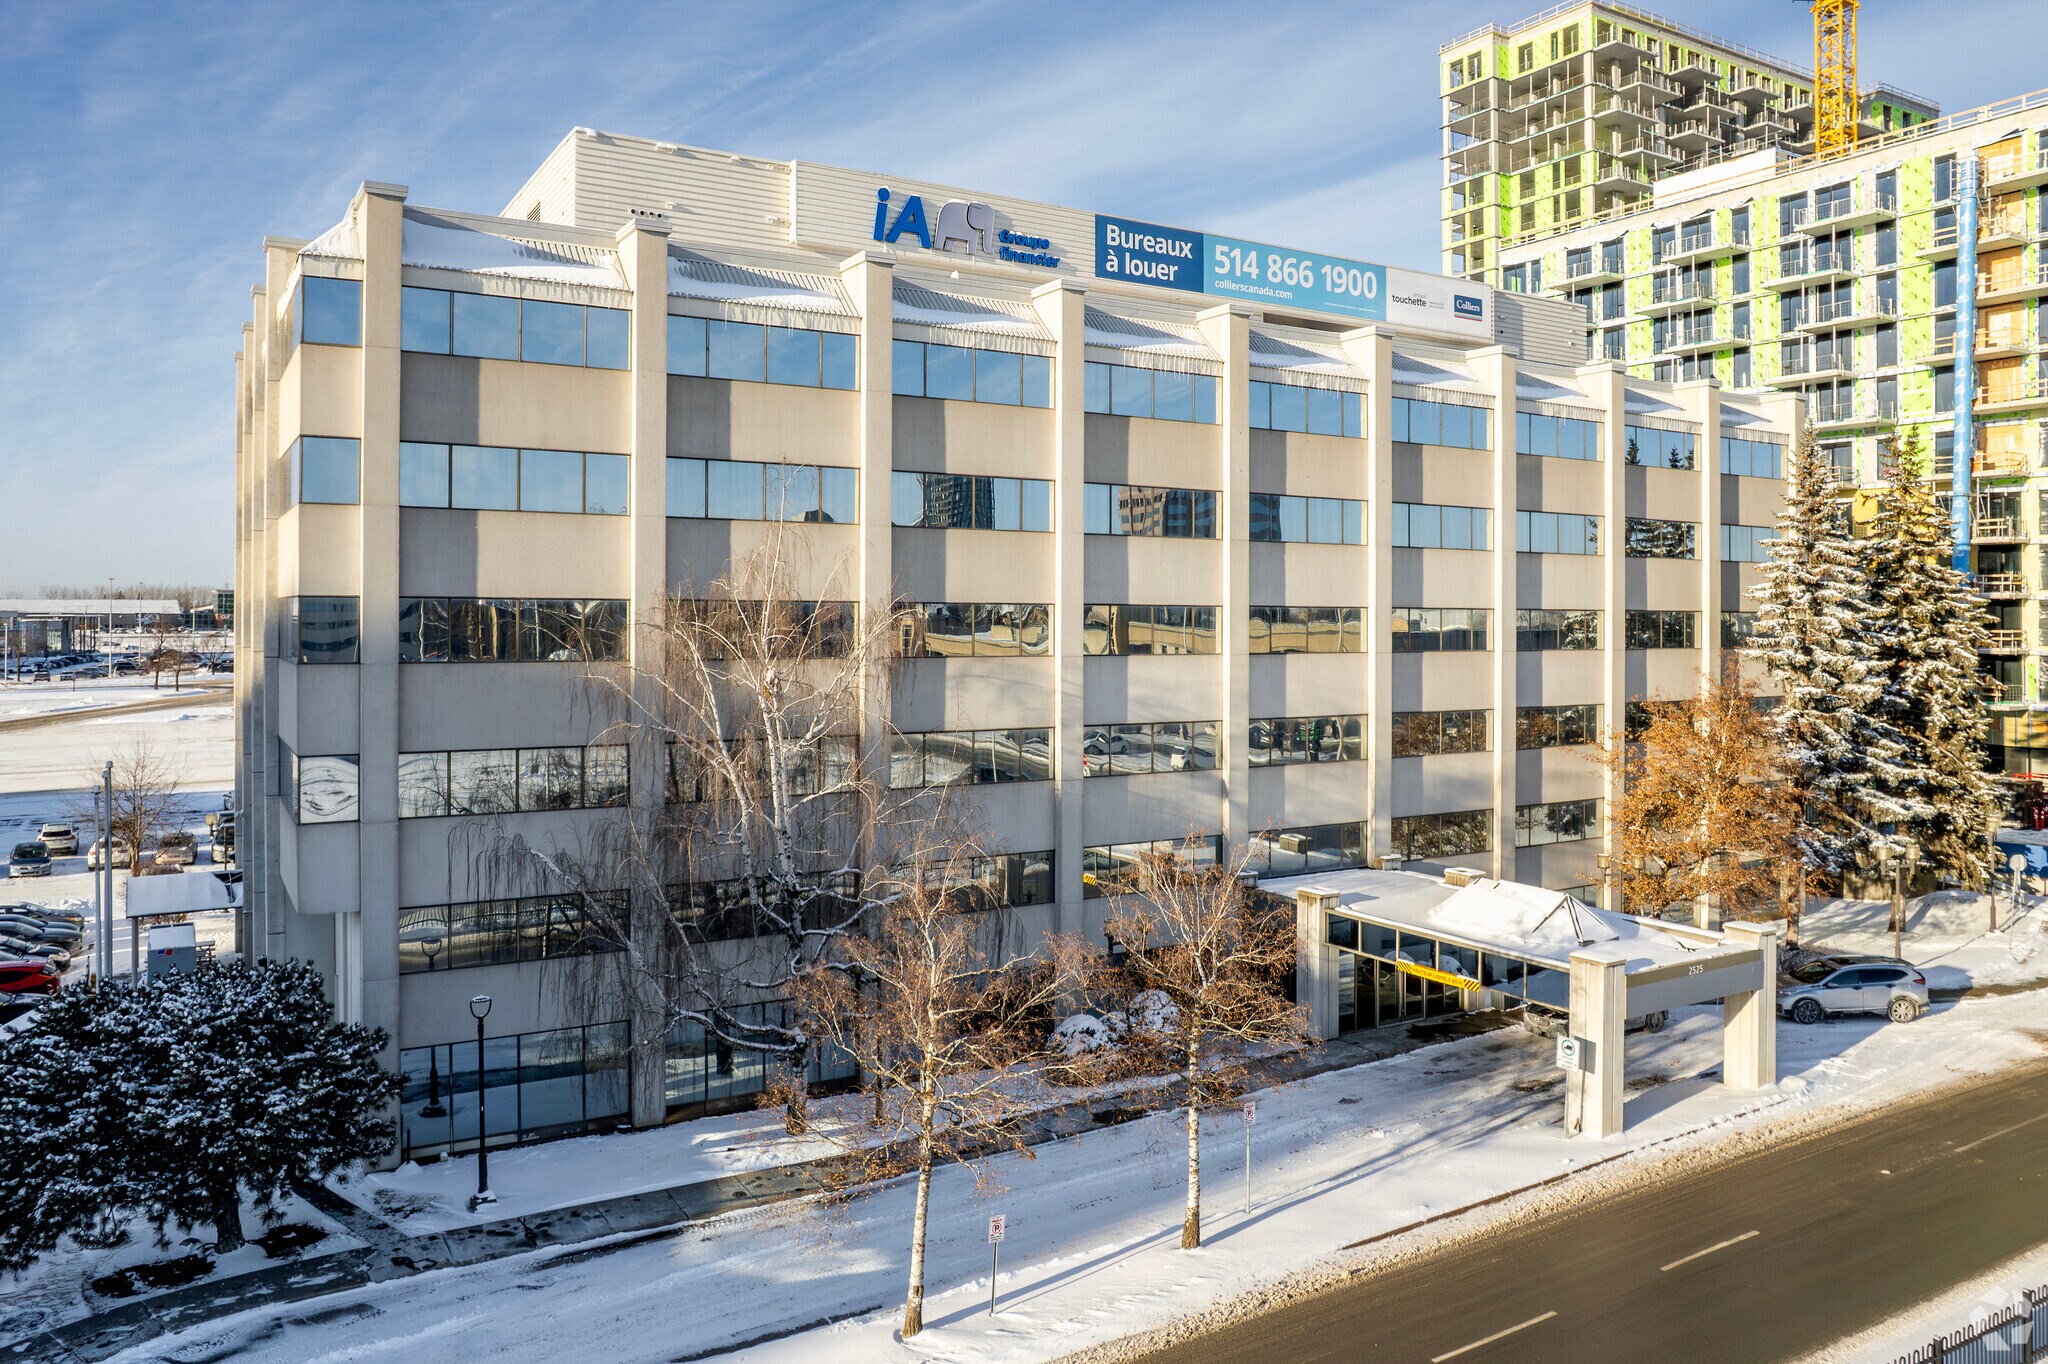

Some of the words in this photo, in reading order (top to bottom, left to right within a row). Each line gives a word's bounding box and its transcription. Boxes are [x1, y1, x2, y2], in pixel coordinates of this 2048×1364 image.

[872, 186, 932, 249] iA
[999, 229, 1050, 250] Groupe
[1106, 223, 1192, 259] Bureaux
[999, 246, 1060, 268] financier
[1105, 248, 1119, 273] à
[1125, 252, 1178, 282] louer
[1214, 244, 1260, 280] 514
[1267, 254, 1314, 289] 866
[1320, 264, 1377, 299] 1900
[1214, 279, 1293, 300] collierscanada.com
[1391, 294, 1427, 308] touchette
[1456, 299, 1481, 313] Colliers
[1688, 964, 1704, 976] 2525
[994, 1224, 1000, 1232] P
